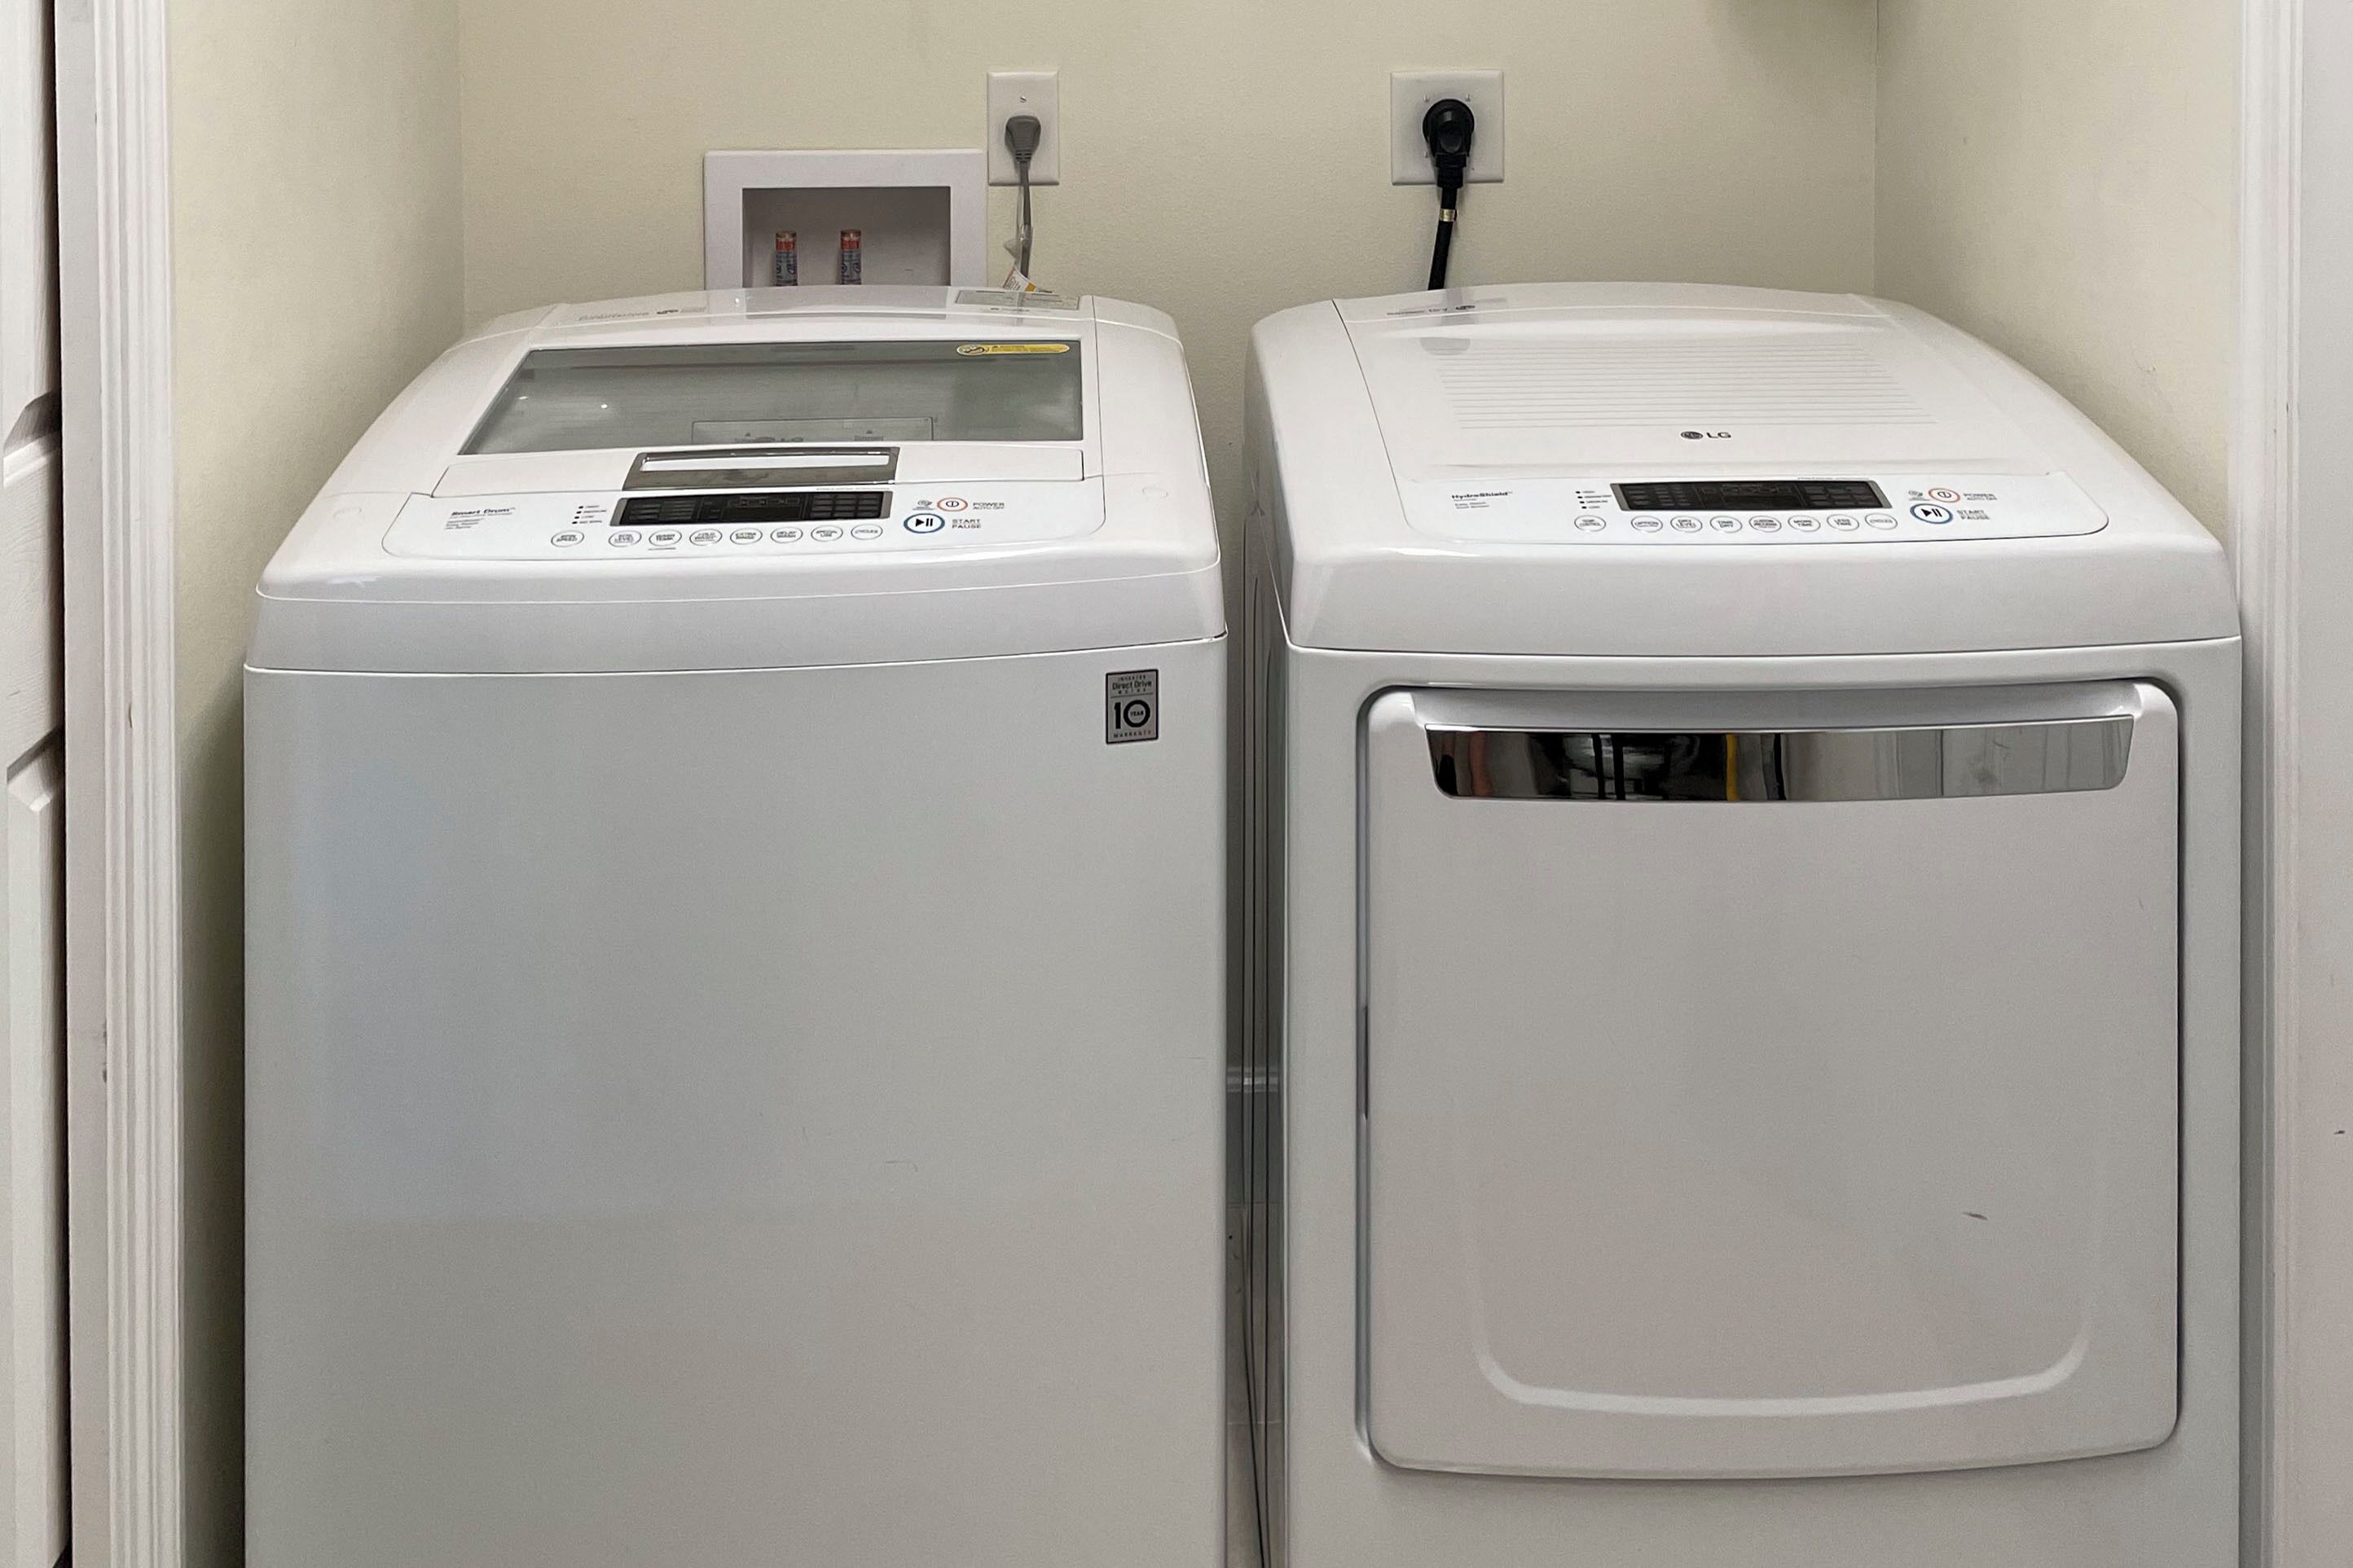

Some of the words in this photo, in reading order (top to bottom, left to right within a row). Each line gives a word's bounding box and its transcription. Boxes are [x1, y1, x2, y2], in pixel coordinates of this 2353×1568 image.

[1112, 682, 1133, 690] Direct
[1133, 680, 1152, 688] Drive
[1114, 699, 1151, 730] 10
[1113, 730, 1152, 739] WARRANTY
